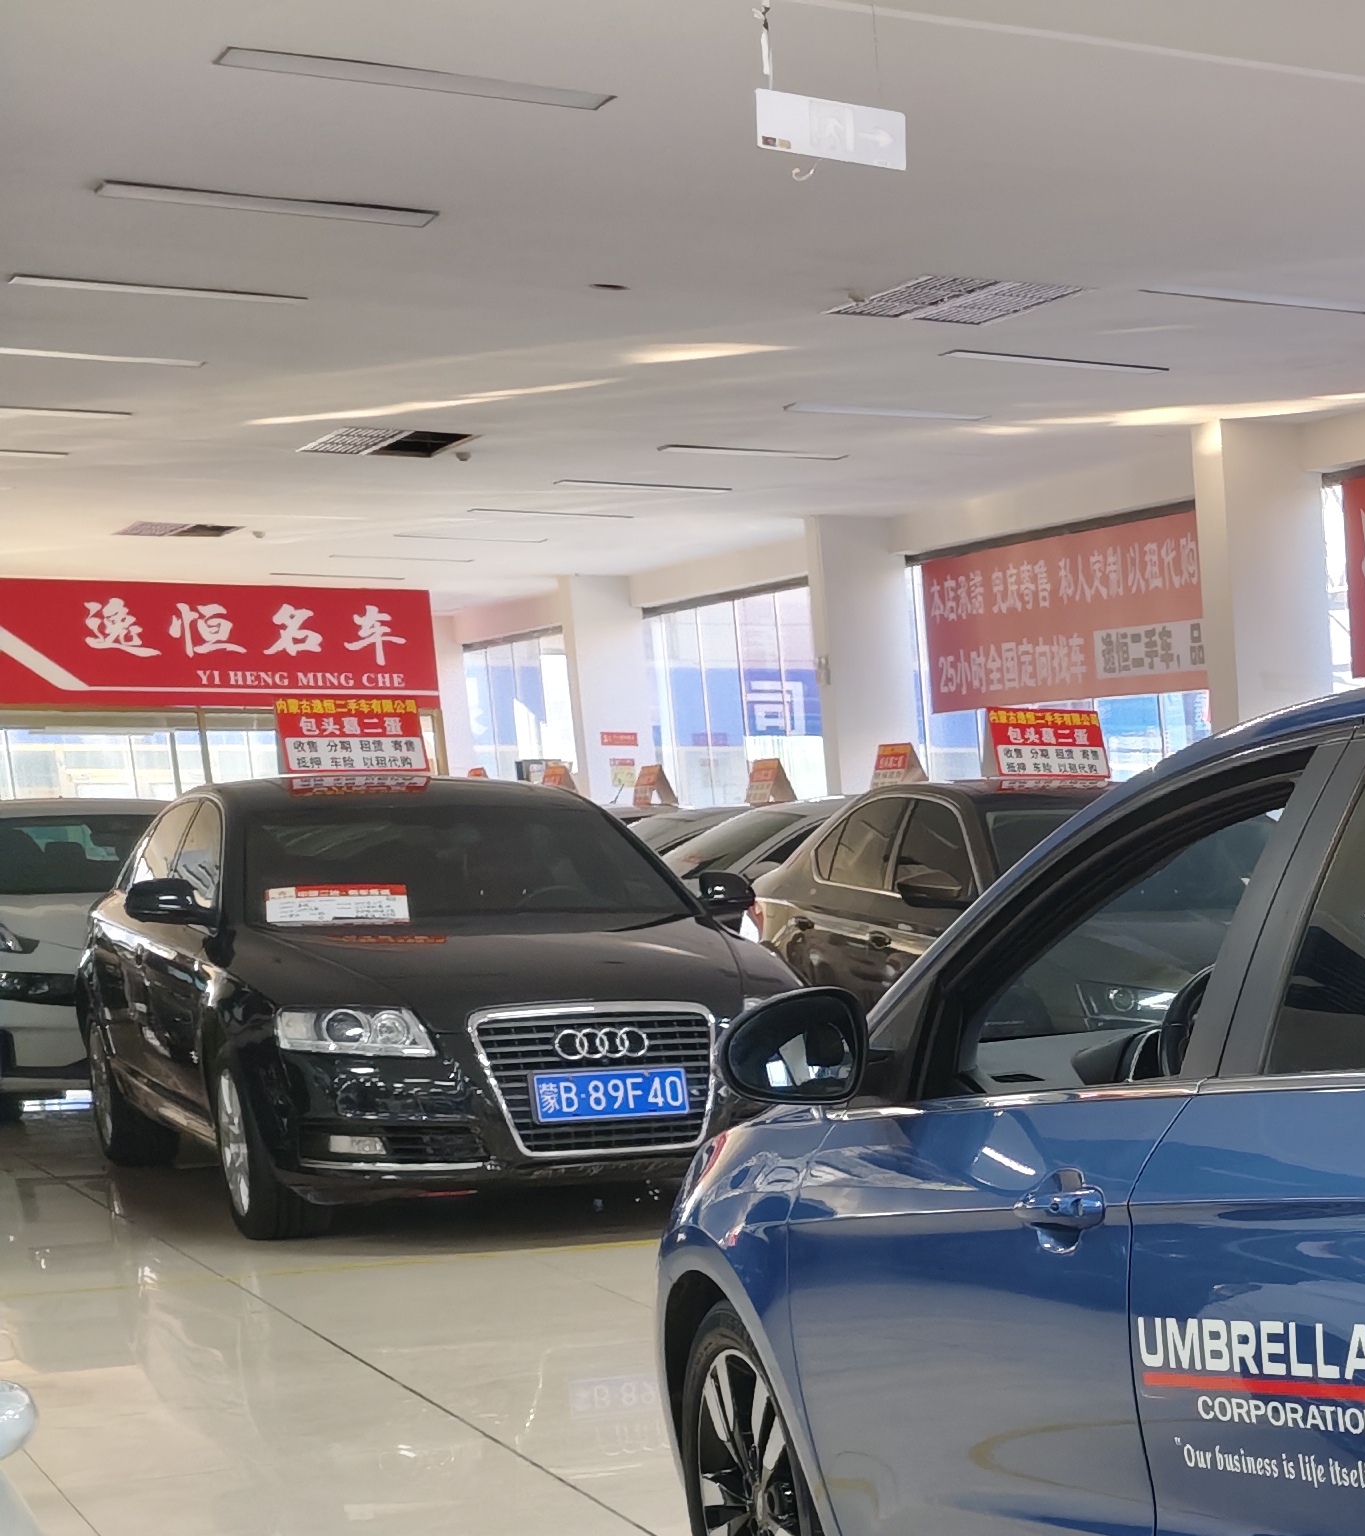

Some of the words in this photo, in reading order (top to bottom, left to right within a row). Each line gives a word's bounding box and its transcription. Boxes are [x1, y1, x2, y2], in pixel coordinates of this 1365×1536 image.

[84, 598, 406, 665] 逸恒名车
[197, 670, 220, 685] YI
[228, 671, 289, 686] HENG
[296, 672, 354, 687] MING
[362, 673, 406, 687] CHE
[1217, 1445, 1279, 1478] business
[1282, 1453, 1296, 1480] is
[1297, 1453, 1326, 1489] life
